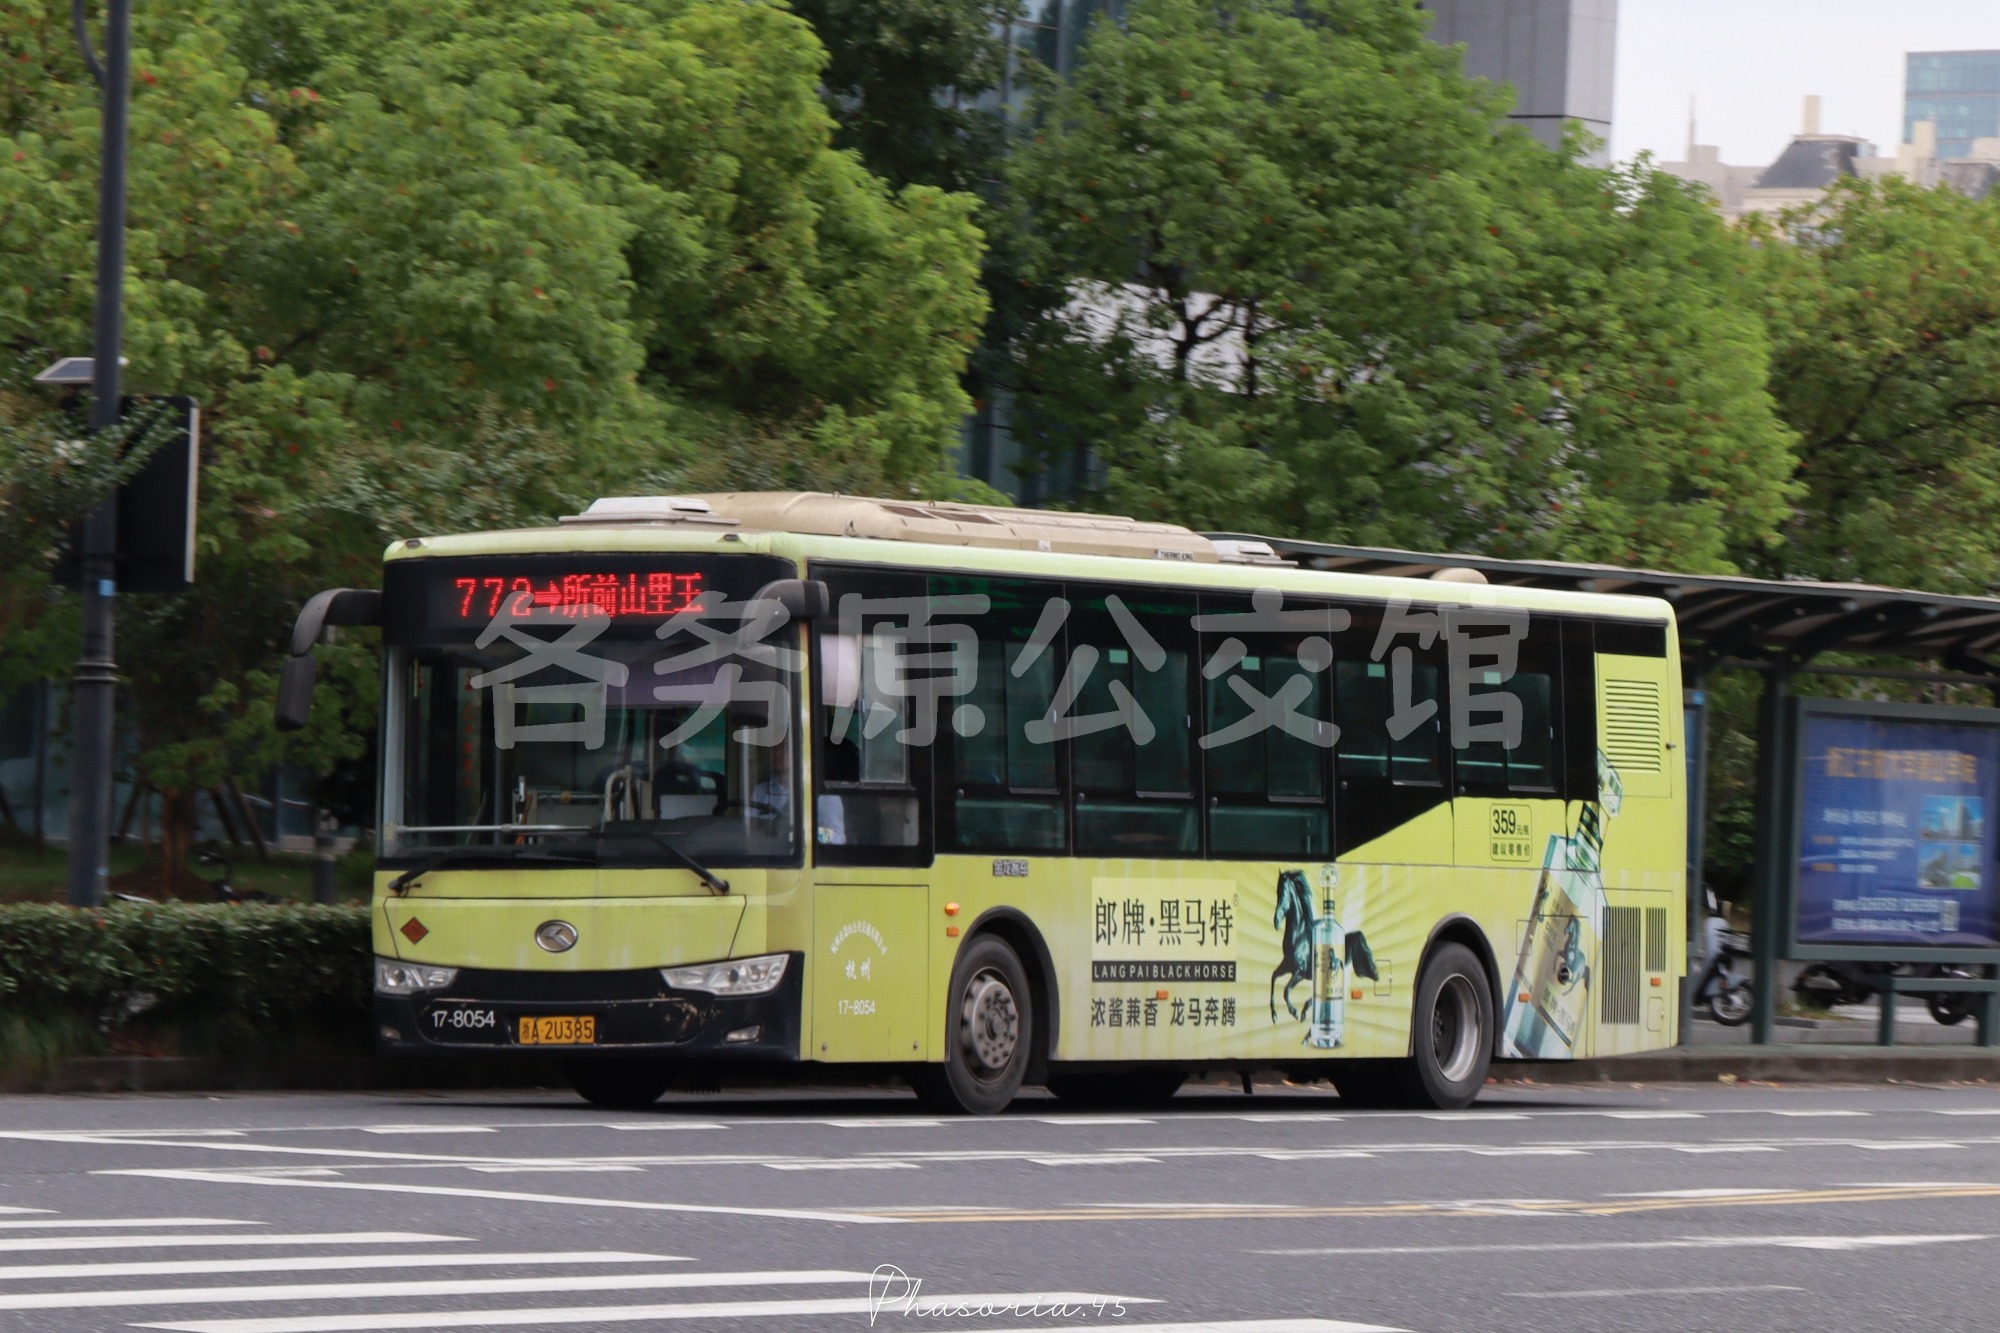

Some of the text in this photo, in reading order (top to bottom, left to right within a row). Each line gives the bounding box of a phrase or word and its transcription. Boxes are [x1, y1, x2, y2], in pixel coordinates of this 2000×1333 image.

[456, 578, 531, 617] 772
[1095, 897, 1233, 946] 郎牌·黑马特
[845, 957, 871, 981] 杭州
[1094, 964, 1234, 979] LANG PAI BLACK HORSE
[431, 1010, 496, 1028] 17-8054
[838, 999, 876, 1015] 17-8054
[1091, 996, 1236, 1028] 浓酱兼香 龙马奔腾
